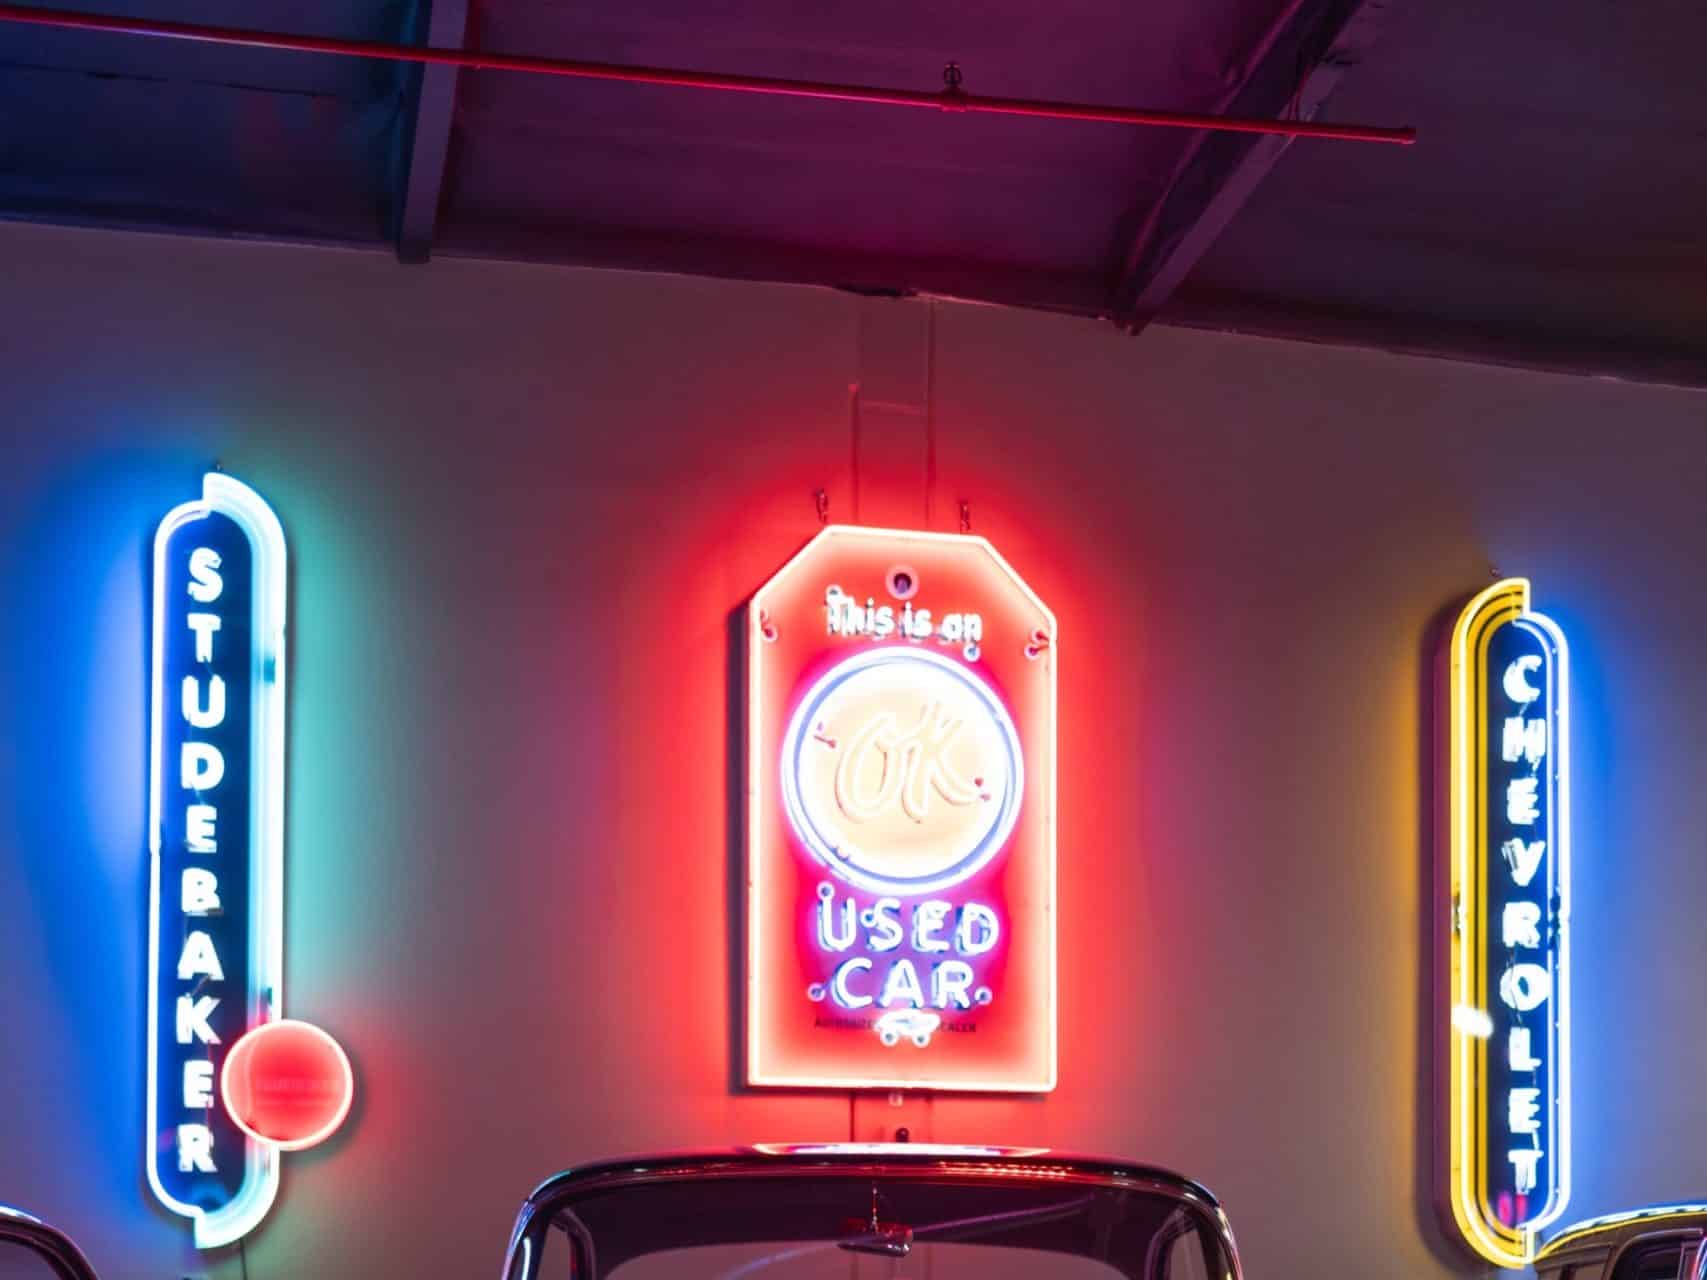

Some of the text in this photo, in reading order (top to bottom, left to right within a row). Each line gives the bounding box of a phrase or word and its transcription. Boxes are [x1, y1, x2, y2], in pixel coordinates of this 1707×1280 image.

[826, 594, 983, 643] This is an
[834, 701, 980, 824] OK
[175, 547, 226, 1174] STUDEBAKER
[818, 896, 1000, 956] USED
[1499, 655, 1550, 1194] CHEVROLET
[830, 957, 974, 1010] CAR
